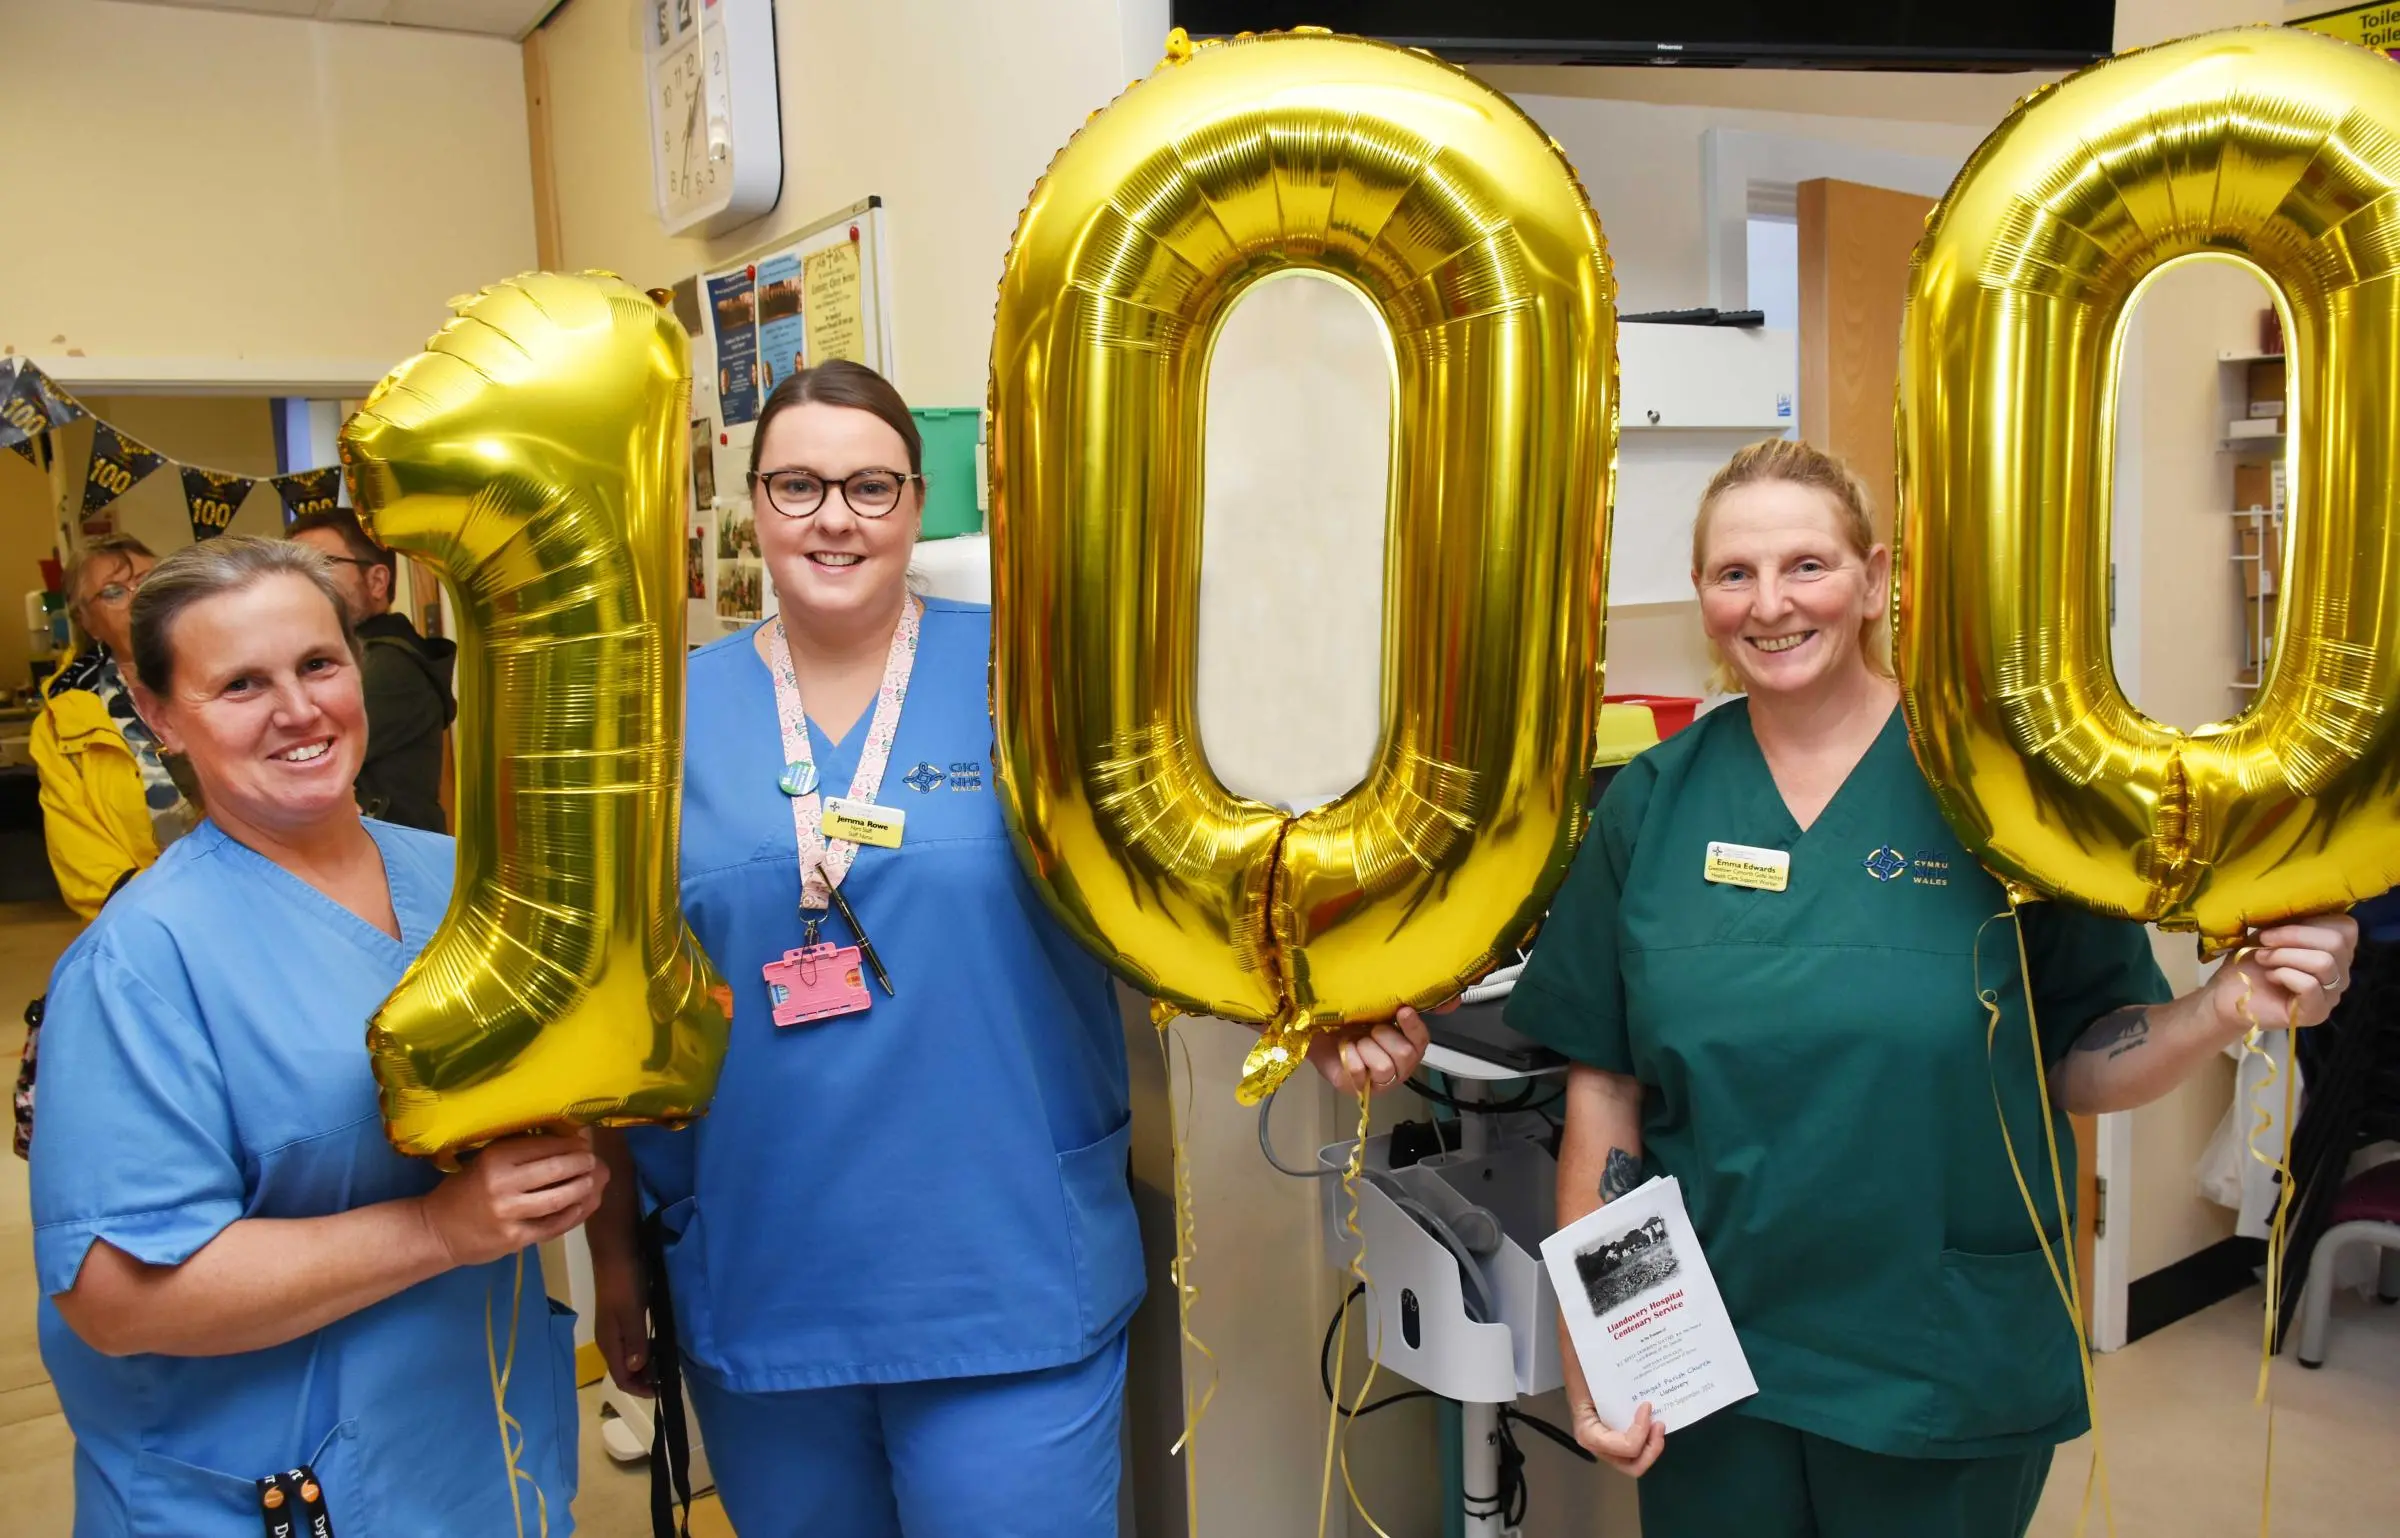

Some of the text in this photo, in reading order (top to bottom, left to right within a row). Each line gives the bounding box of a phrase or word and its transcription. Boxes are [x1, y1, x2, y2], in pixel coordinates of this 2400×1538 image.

[685, 53, 696, 77] 12
[713, 51, 721, 76] 2
[3, 397, 47, 437] 100
[88, 458, 132, 494] 100
[192, 498, 231, 528] 100
[949, 762, 980, 772] GIG
[950, 777, 982, 787] NHS
[837, 815, 889, 831] Jemma Rowe
[1717, 859, 1776, 873] Emma Edwards
[1914, 860, 1948, 869] CYMRU
[1913, 877, 1948, 886] WALES
[1607, 1289, 1684, 1333] Llandovery Hospital
[1613, 1316, 1652, 1341] Centenary
[1653, 1301, 1684, 1319] Service
[1663, 1372, 1686, 1385] Parish
[1687, 1360, 1712, 1374] Church
[1659, 1380, 1689, 1397] Llandovery
